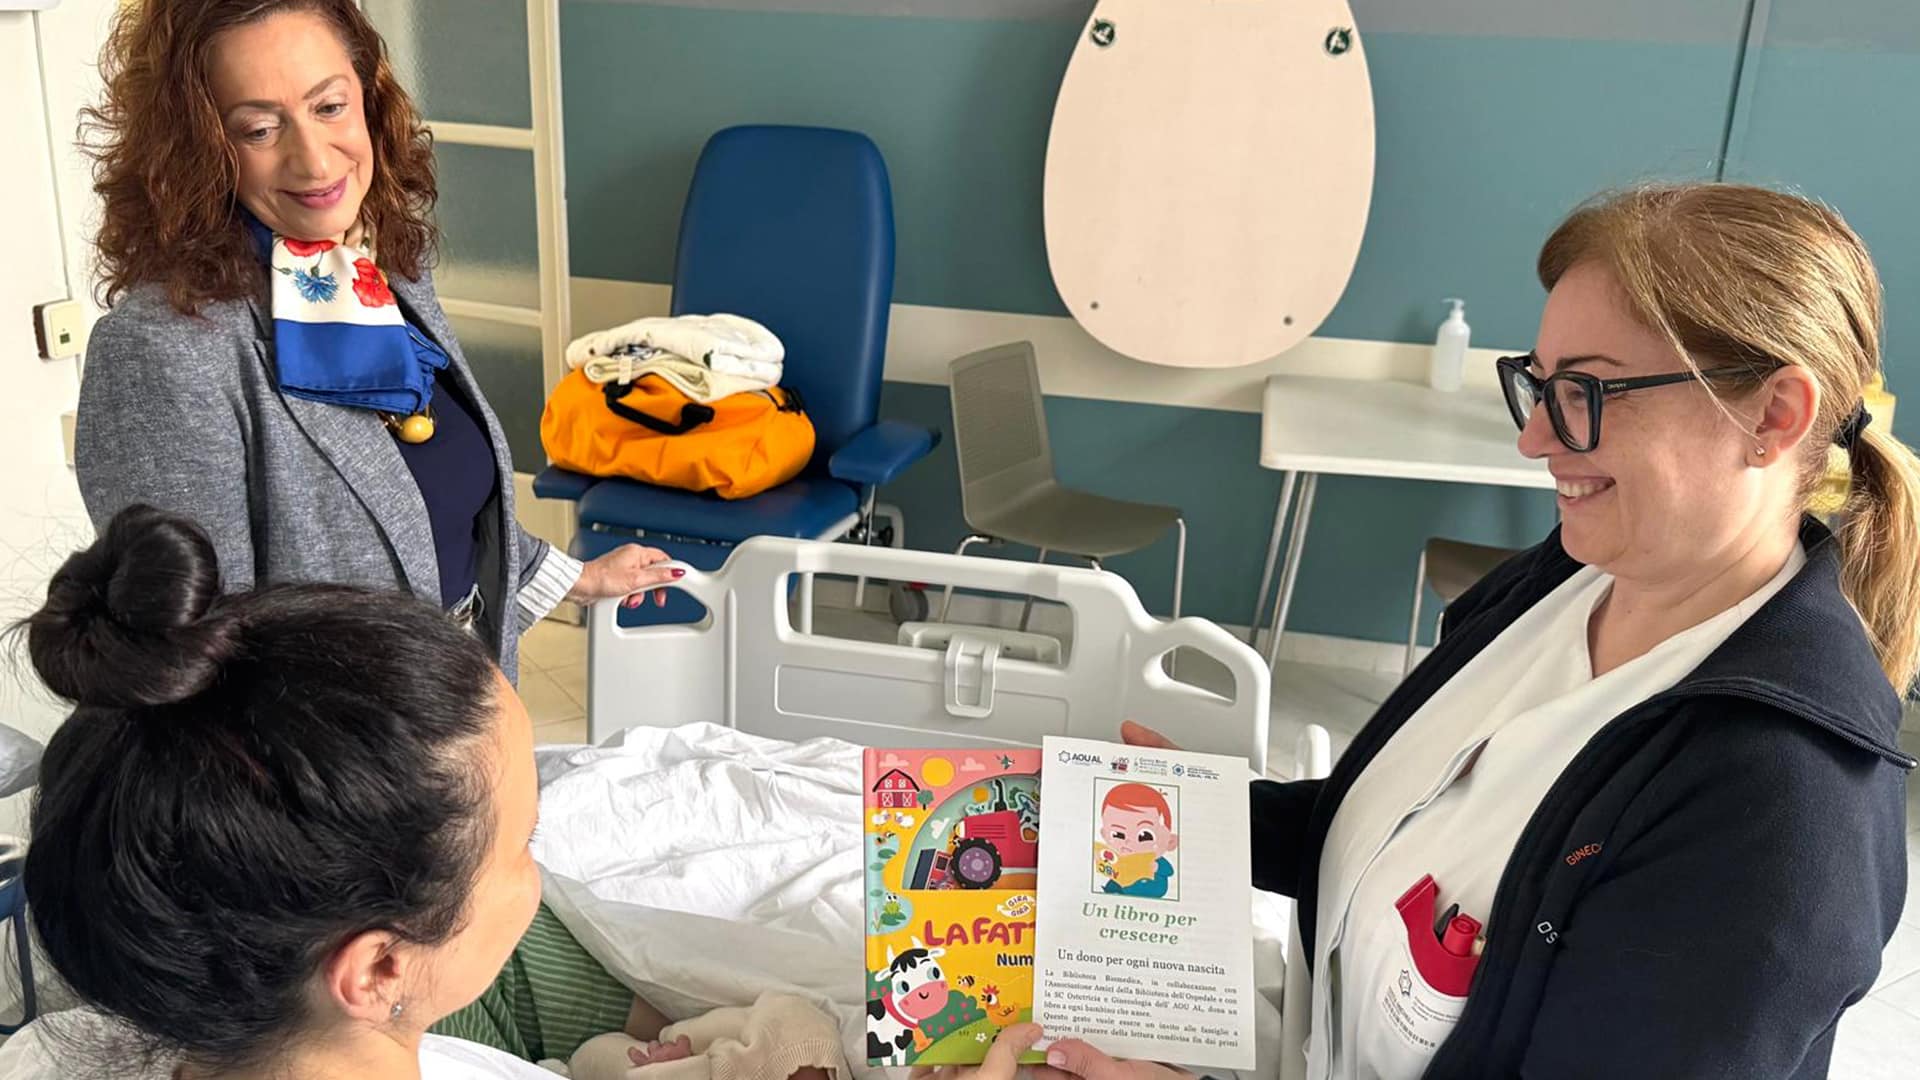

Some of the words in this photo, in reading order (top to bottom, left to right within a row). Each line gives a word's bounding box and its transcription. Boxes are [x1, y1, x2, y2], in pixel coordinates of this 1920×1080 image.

[1007, 895, 1028, 907] GIRA
[1011, 904, 1030, 917] GIRA
[1082, 902, 1107, 918] Un
[1114, 904, 1159, 923] libro
[1164, 912, 1197, 927] per
[924, 920, 969, 945] LA
[1099, 926, 1179, 945] crescere
[997, 953, 1034, 967] Num
[1057, 948, 1073, 961] Un
[1076, 950, 1103, 963] dono
[1105, 955, 1124, 967] per
[1126, 956, 1150, 969] ogni
[1152, 960, 1185, 972] nuova
[1187, 963, 1225, 975] nascita
[1062, 970, 1096, 980] Biblioteca
[1166, 980, 1216, 991] collaborazione
[1094, 984, 1114, 993] Amici
[1116, 986, 1133, 995] della
[1135, 988, 1169, 998] Biblioteca
[1043, 1001, 1061, 1009] libro
[1068, 1003, 1083, 1012] ogni
[1085, 1004, 1116, 1014] bambino
[1117, 1007, 1129, 1015] che
[1054, 991, 1064, 999] SC
[1067, 992, 1101, 1002] Ostetricia
[1111, 996, 1152, 1007] Ginecologia
[1208, 1006, 1225, 1014] dona
[1043, 1012, 1068, 1020] Questo
[1072, 1015, 1091, 1023] gesto
[1096, 1016, 1115, 1024] vuole
[1159, 1021, 1180, 1030] invito
[1201, 1025, 1229, 1036] famiglie
[1043, 1023, 1072, 1033] scoprire
[1082, 1026, 1108, 1035] piacere
[1110, 1028, 1128, 1037] della
[1130, 1030, 1154, 1039] lettura
[1156, 1032, 1190, 1042] condivisa
[1204, 1037, 1216, 1045] dai
[1218, 1039, 1238, 1048] primi
